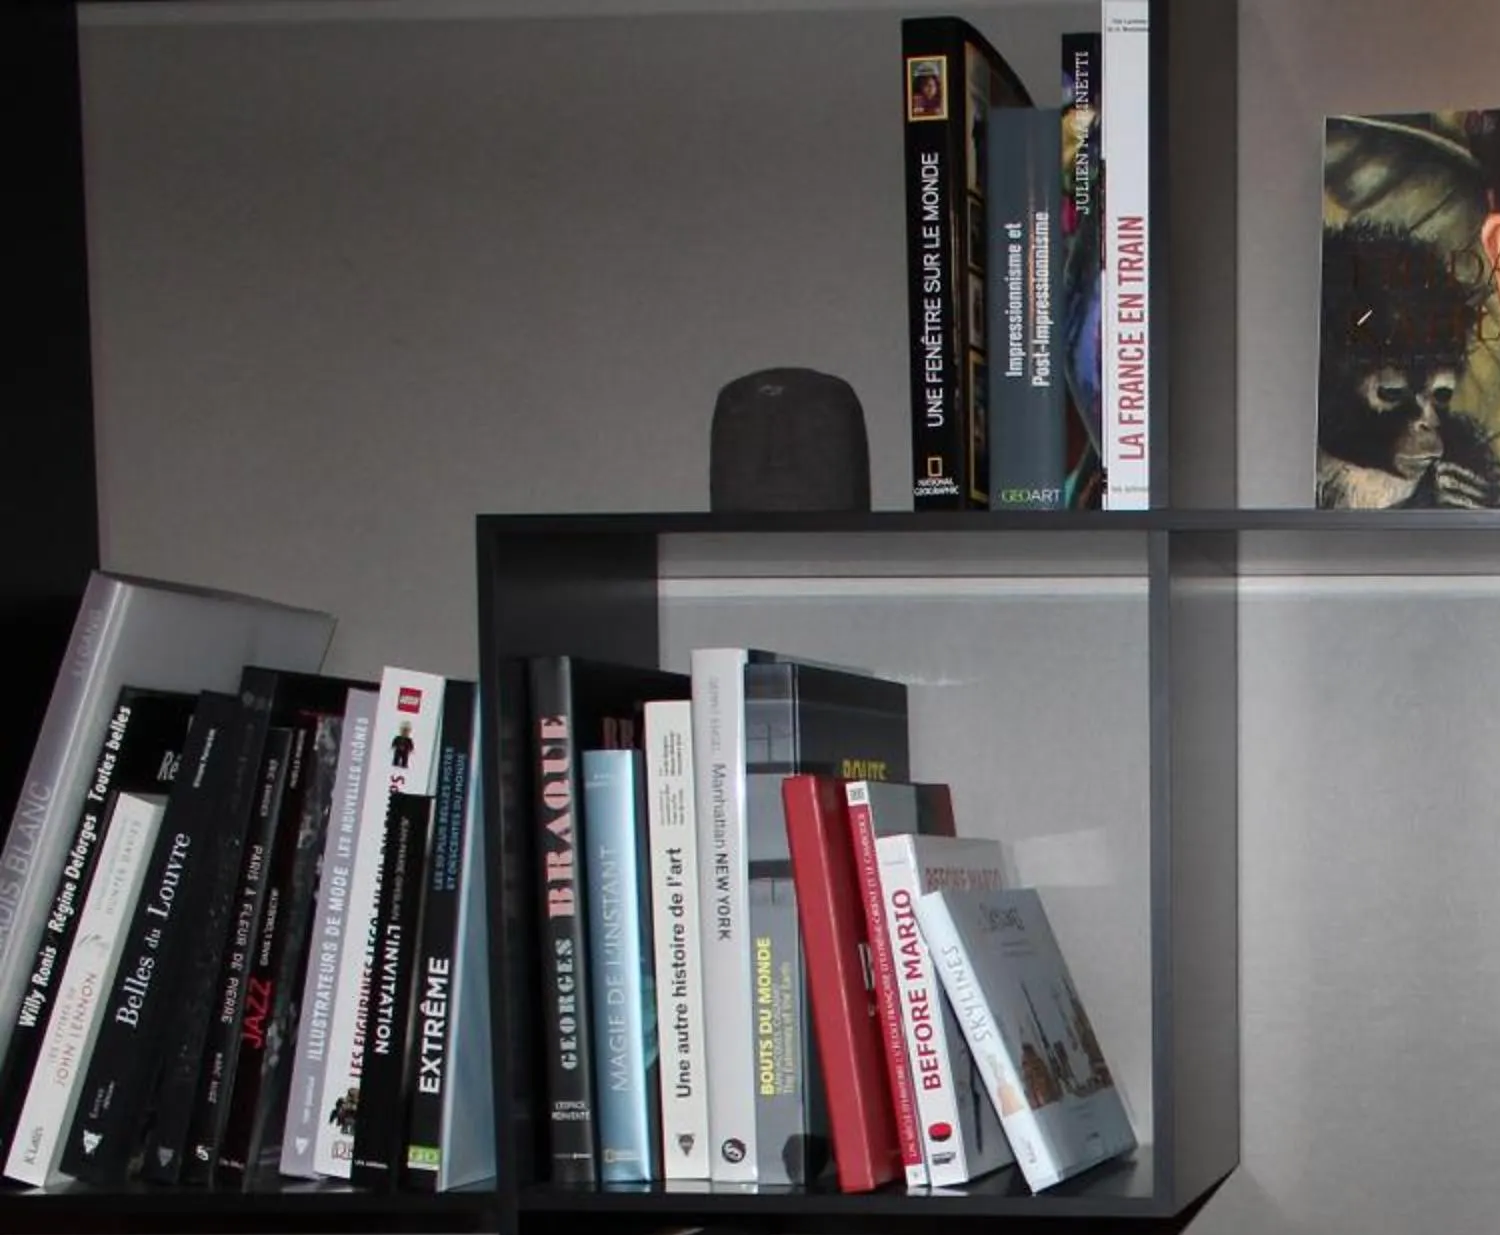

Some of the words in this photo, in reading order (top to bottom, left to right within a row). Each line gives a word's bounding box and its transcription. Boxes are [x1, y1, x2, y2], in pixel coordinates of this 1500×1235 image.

[921, 153, 939, 221] MONDE
[923, 226, 940, 248] LE
[1005, 223, 1021, 238] et
[1117, 216, 1144, 285] TRAIN
[924, 254, 941, 293] SUR
[1032, 212, 1053, 387] Post-Impressionnisme
[920, 298, 942, 382] FENÊTRE
[1005, 244, 1023, 377] Impressionnisme
[1118, 293, 1144, 323] EN
[925, 388, 944, 427] UNE
[1118, 333, 1144, 425] FRANCE
[1119, 433, 1144, 460] LA
[101, 705, 132, 749] belles
[86, 754, 119, 802] Toutes
[61, 814, 99, 878] Deforges
[540, 714, 576, 918] BRAQUE
[147, 832, 191, 917] Louvre
[663, 848, 683, 887] l'art
[47, 882, 78, 932] Régine
[599, 844, 624, 965] L'INSTANT
[666, 893, 685, 918] de
[891, 889, 925, 980] MARIO
[30, 945, 57, 985] Ronis
[145, 928, 162, 948] du
[667, 925, 687, 997] histoire
[755, 937, 773, 1003] MONDE
[18, 989, 48, 1027] Willy
[116, 956, 156, 1026] Belles
[241, 975, 273, 1049] JAZZ
[374, 924, 402, 1054] L'INVITATION
[552, 938, 579, 1070] GEORGES
[603, 973, 626, 1003] DE
[419, 957, 450, 1094] EXTRÊME
[672, 1003, 690, 1054] autre
[757, 1008, 773, 1034] DU
[908, 987, 942, 1090] BEFORE
[607, 1015, 631, 1092] MAGIE
[674, 1059, 692, 1099] Une
[757, 1038, 774, 1095] BOUTS
